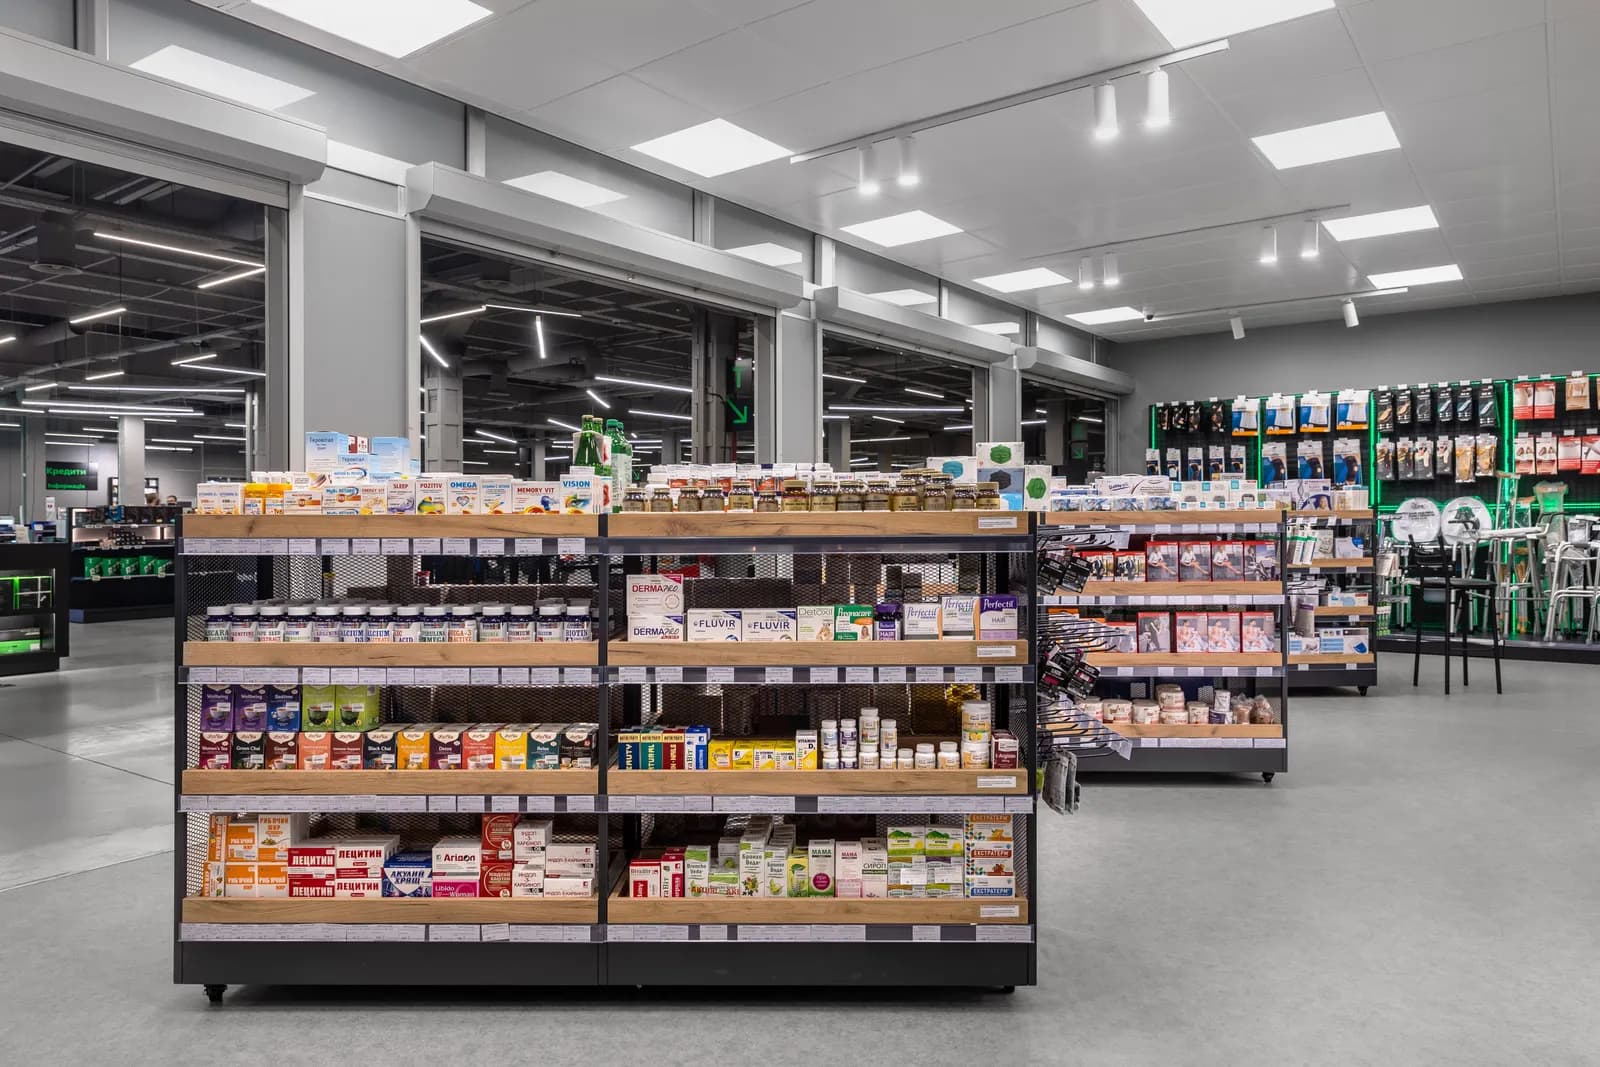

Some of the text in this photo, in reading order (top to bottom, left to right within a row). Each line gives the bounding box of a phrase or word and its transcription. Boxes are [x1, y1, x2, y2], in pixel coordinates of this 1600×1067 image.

[46, 466, 87, 477] Кредити
[392, 482, 409, 490] SLEEP
[419, 482, 443, 490] POZITIV
[449, 481, 478, 489] OMEGA
[562, 480, 591, 488] VISION
[943, 598, 974, 610] Perfectil
[983, 599, 1014, 610] Perfectil
[799, 607, 833, 617] Detoxil
[907, 606, 937, 618] Perfectil
[698, 619, 736, 628] FLUVIR
[752, 621, 790, 630] FLUVIR
[338, 850, 383, 859] ЛЕЦИТИН
[292, 856, 334, 866] ЛЕЦИТИН
[391, 870, 425, 878] АКУЛИЙ
[394, 877, 421, 885] ХРЯЩ
[336, 881, 380, 892] ЛЕЦИТИН
[292, 887, 333, 897] ЛЕЦИТИН
